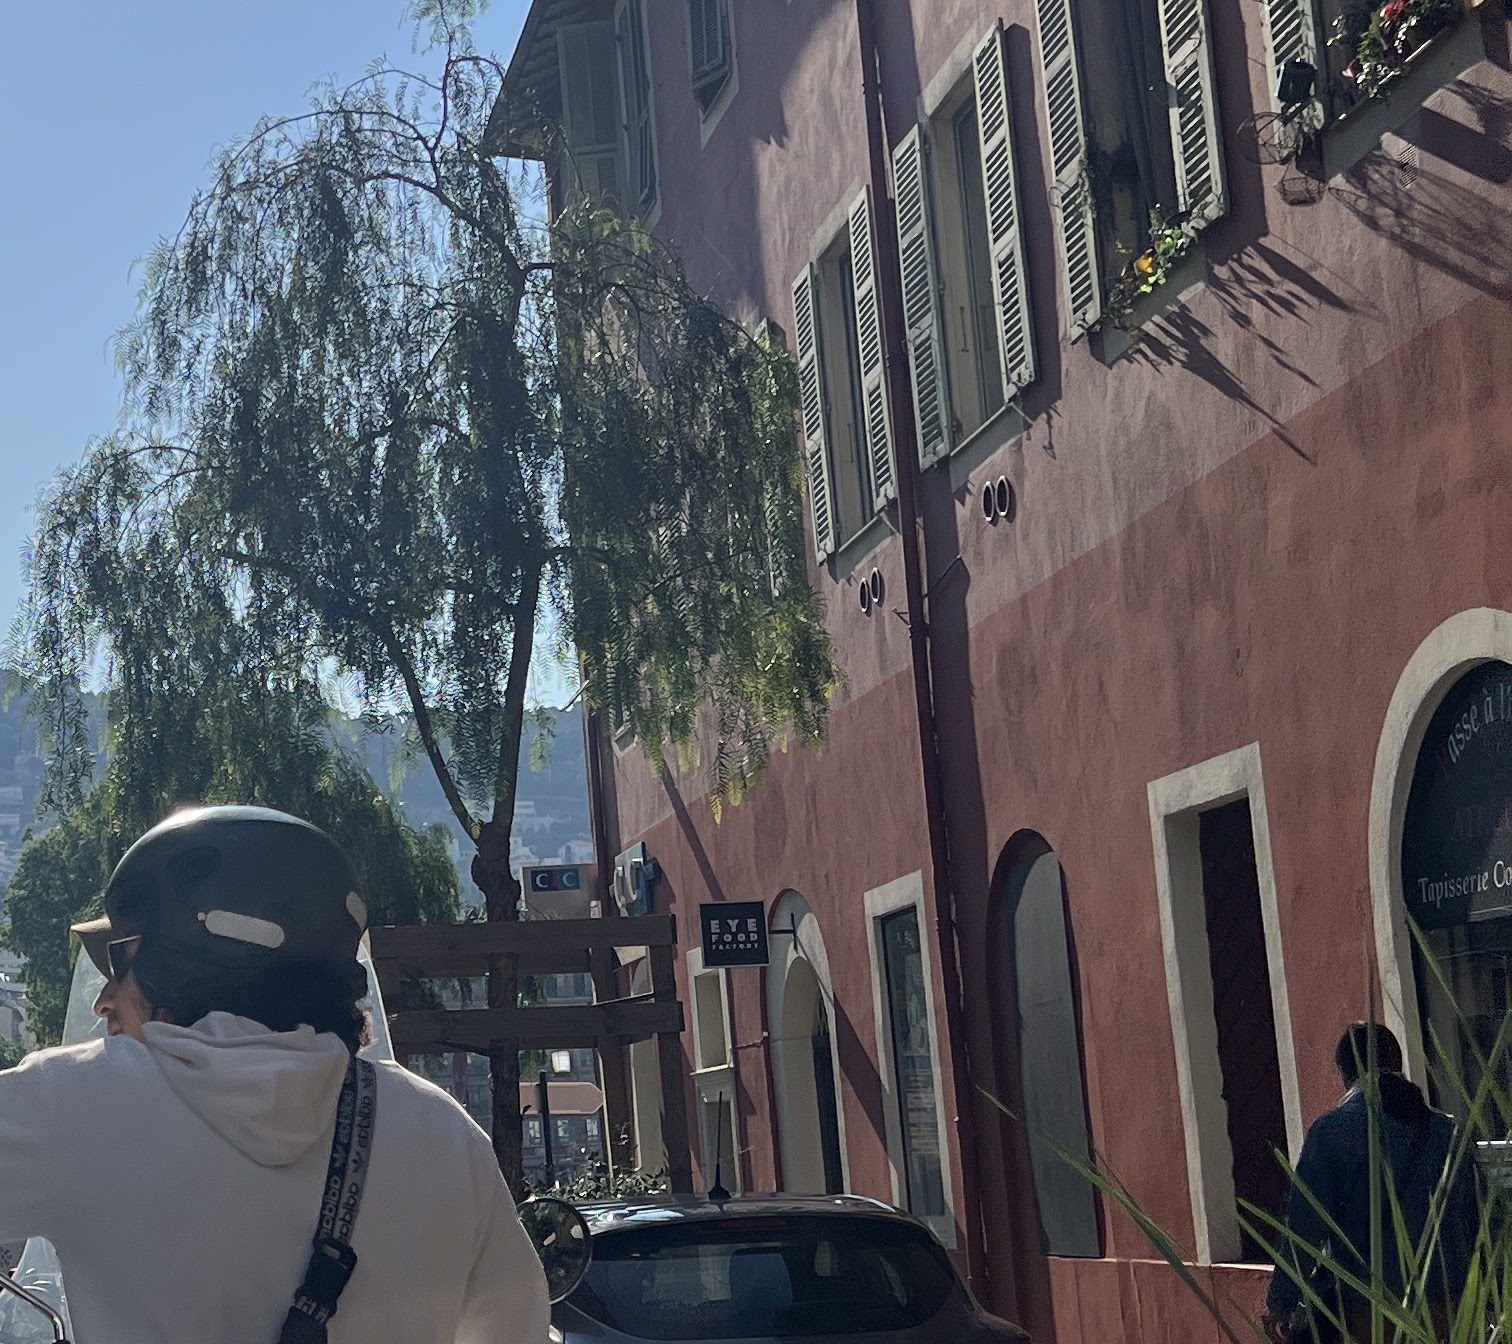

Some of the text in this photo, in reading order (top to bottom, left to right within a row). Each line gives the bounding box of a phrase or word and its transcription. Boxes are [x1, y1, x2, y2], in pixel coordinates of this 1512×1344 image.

[535, 872, 576, 888] CIC
[1417, 866, 1489, 908] Tapisserie
[710, 918, 758, 933] EYE
[711, 933, 758, 943] FOOD
[711, 943, 759, 951] FACTORY
